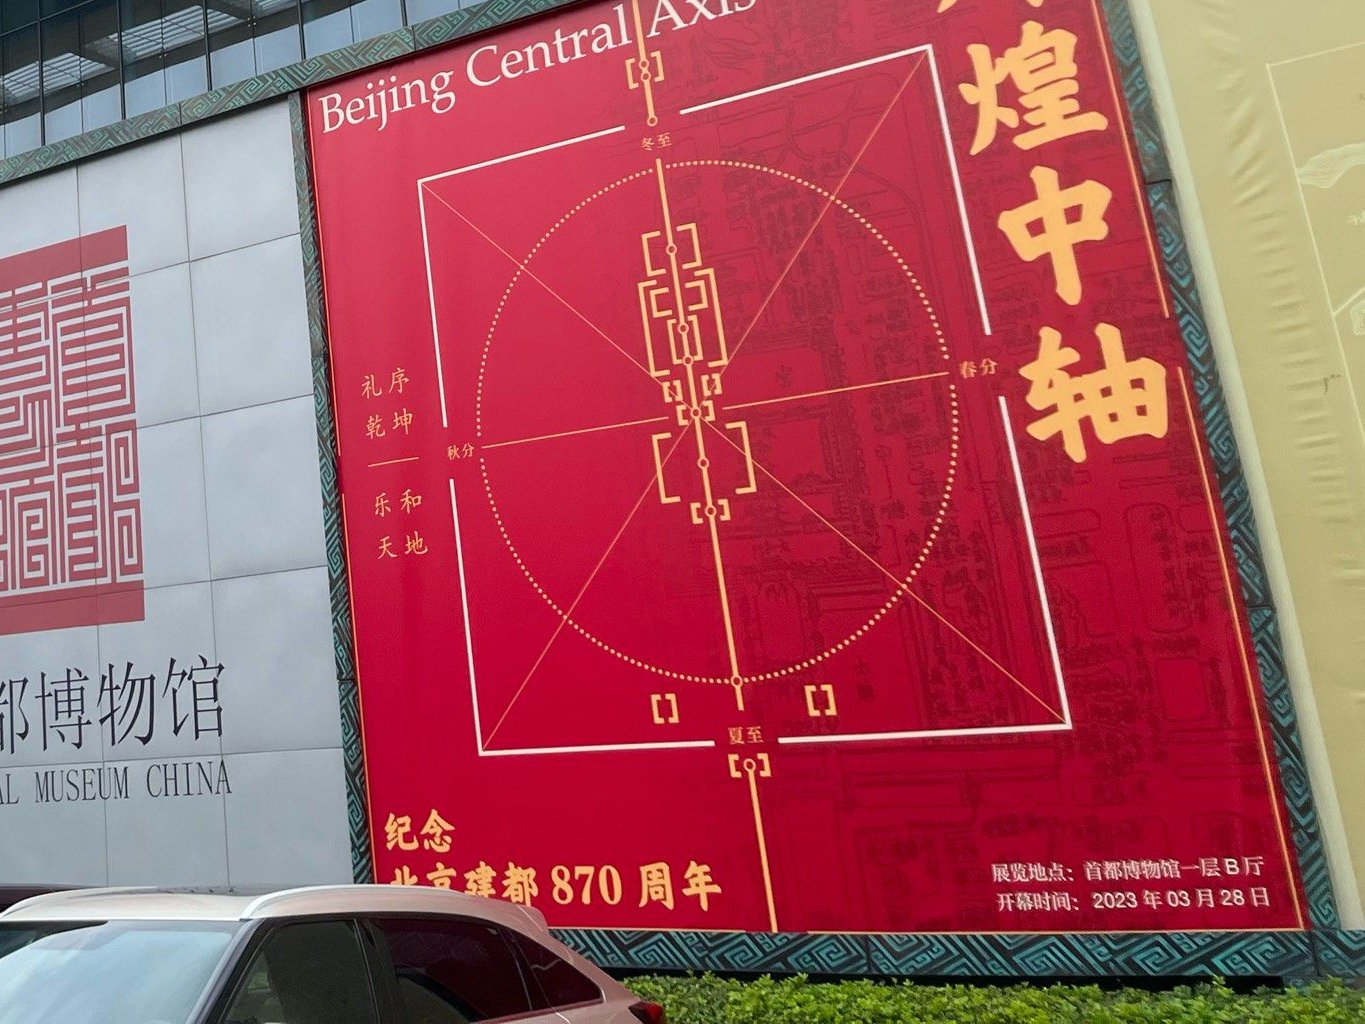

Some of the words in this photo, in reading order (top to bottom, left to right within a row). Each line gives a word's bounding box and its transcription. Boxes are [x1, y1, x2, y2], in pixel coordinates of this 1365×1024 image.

[318, 71, 455, 133] Beijing
[467, 4, 633, 87] Central
[641, 132, 673, 152] 冬至
[361, 367, 410, 400] 礼序
[960, 358, 998, 379] 春分
[365, 408, 413, 440] 乾坤
[446, 442, 475, 461] 秋分
[374, 488, 422, 518] 乐和
[378, 530, 429, 560] 天地
[728, 725, 764, 745] 夏至
[36, 766, 130, 803] MUSEUM
[147, 759, 233, 798] CHINA
[384, 808, 455, 853] 纪念
